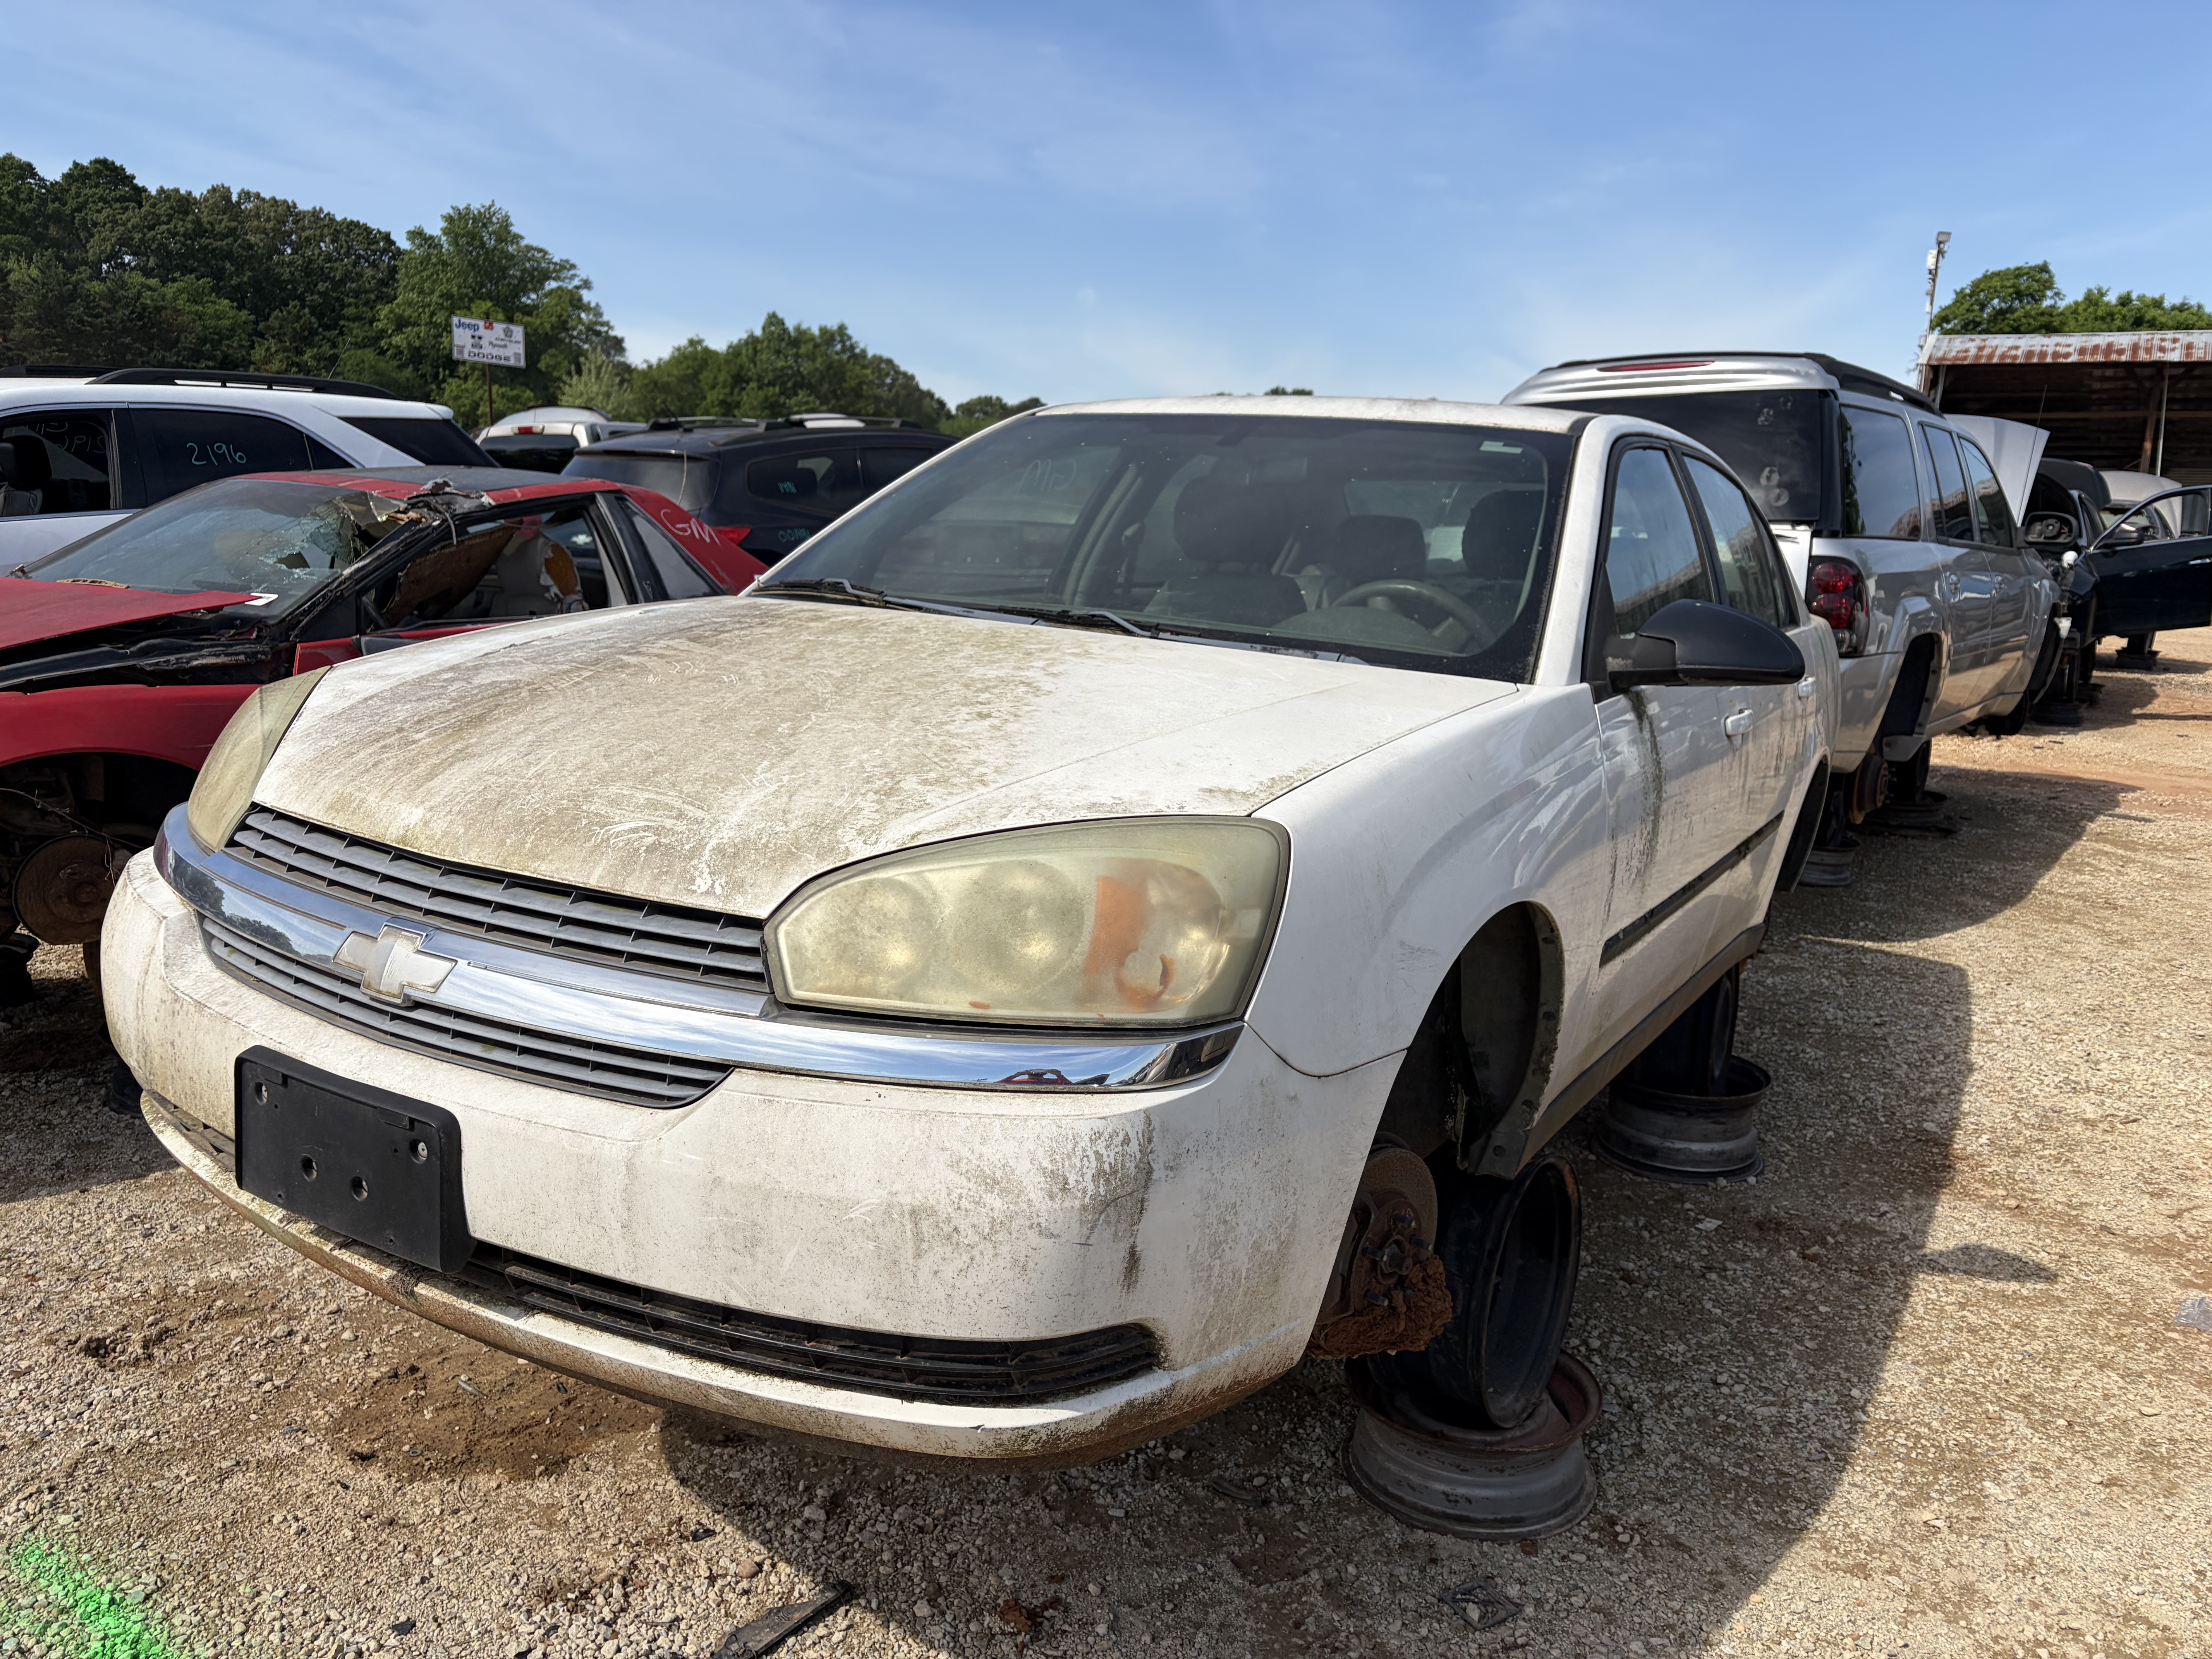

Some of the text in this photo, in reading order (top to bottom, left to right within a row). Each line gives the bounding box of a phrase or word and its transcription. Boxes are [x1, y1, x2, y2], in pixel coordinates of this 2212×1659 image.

[455, 319, 479, 332] Jeep
[468, 350, 511, 361] DODGE
[187, 443, 246, 465] 2196
[661, 509, 722, 548] GM
